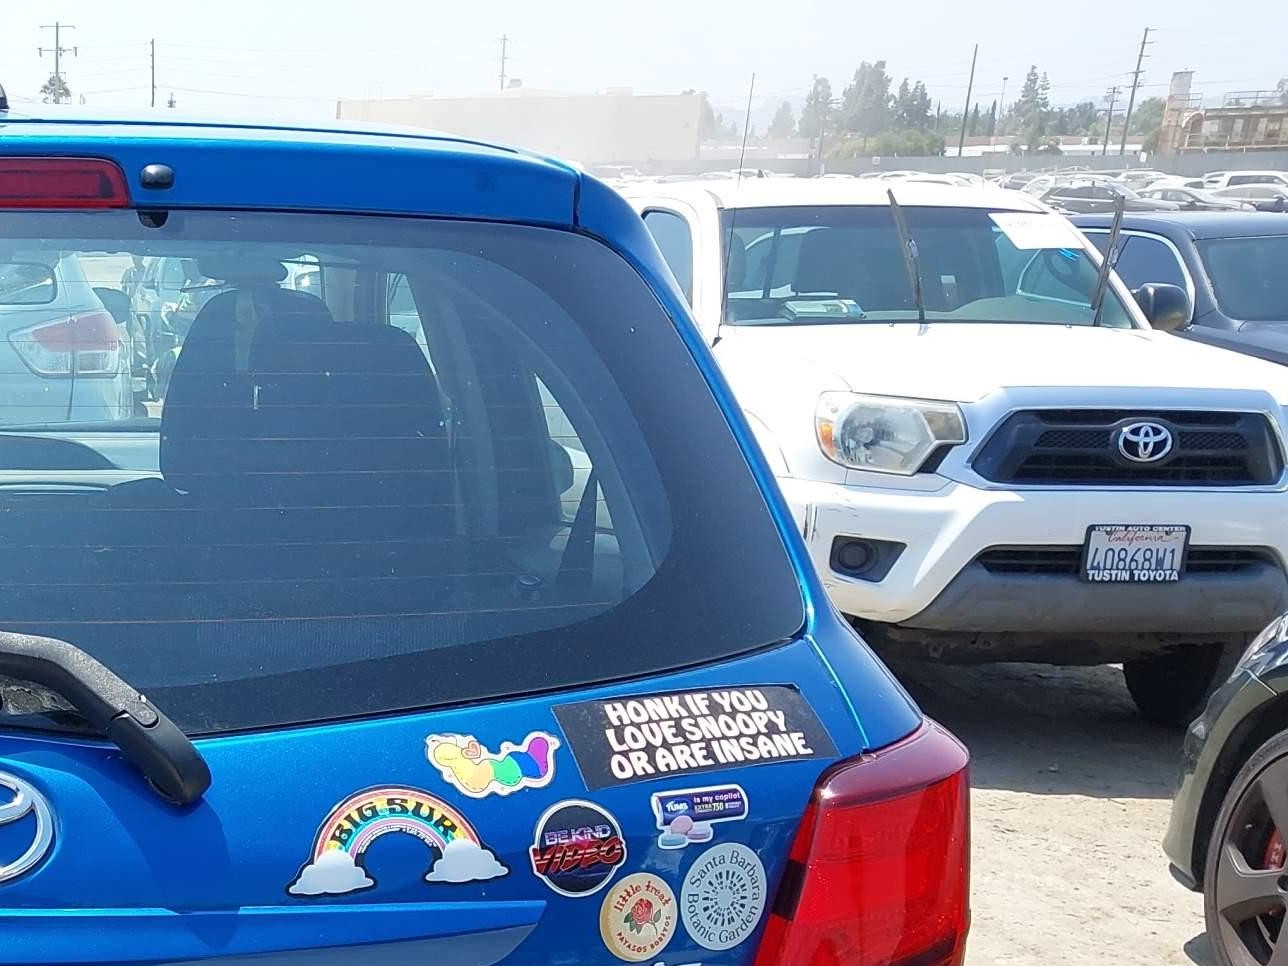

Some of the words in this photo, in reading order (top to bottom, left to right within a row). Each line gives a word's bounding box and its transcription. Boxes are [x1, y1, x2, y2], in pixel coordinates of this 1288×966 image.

[1108, 530, 1169, 545] California
[1088, 570, 1130, 581] TUSTIN
[1133, 570, 1178, 581] TOYOTA
[1091, 547, 1176, 570] 40868W1
[604, 695, 684, 726] HONK
[684, 694, 711, 716] IF
[712, 690, 769, 713] YOU
[605, 719, 681, 752] LOVE
[681, 711, 787, 742] SNOOPY
[610, 751, 656, 780] OR
[655, 741, 714, 772] ARE
[711, 732, 814, 763] INSANE
[666, 800, 689, 812] TUMS
[702, 795, 713, 803] my
[714, 792, 741, 801] copilot
[330, 801, 380, 846] BIG
[386, 797, 458, 842] SUR
[544, 830, 569, 846] BE
[570, 824, 611, 842] KIND
[532, 836, 622, 874] VIDEO
[689, 855, 726, 888] Santa
[729, 850, 760, 901] Barbara
[614, 884, 642, 912] little
[645, 880, 671, 907] treat
[687, 893, 716, 942] Botanic
[719, 906, 759, 944] Garden
